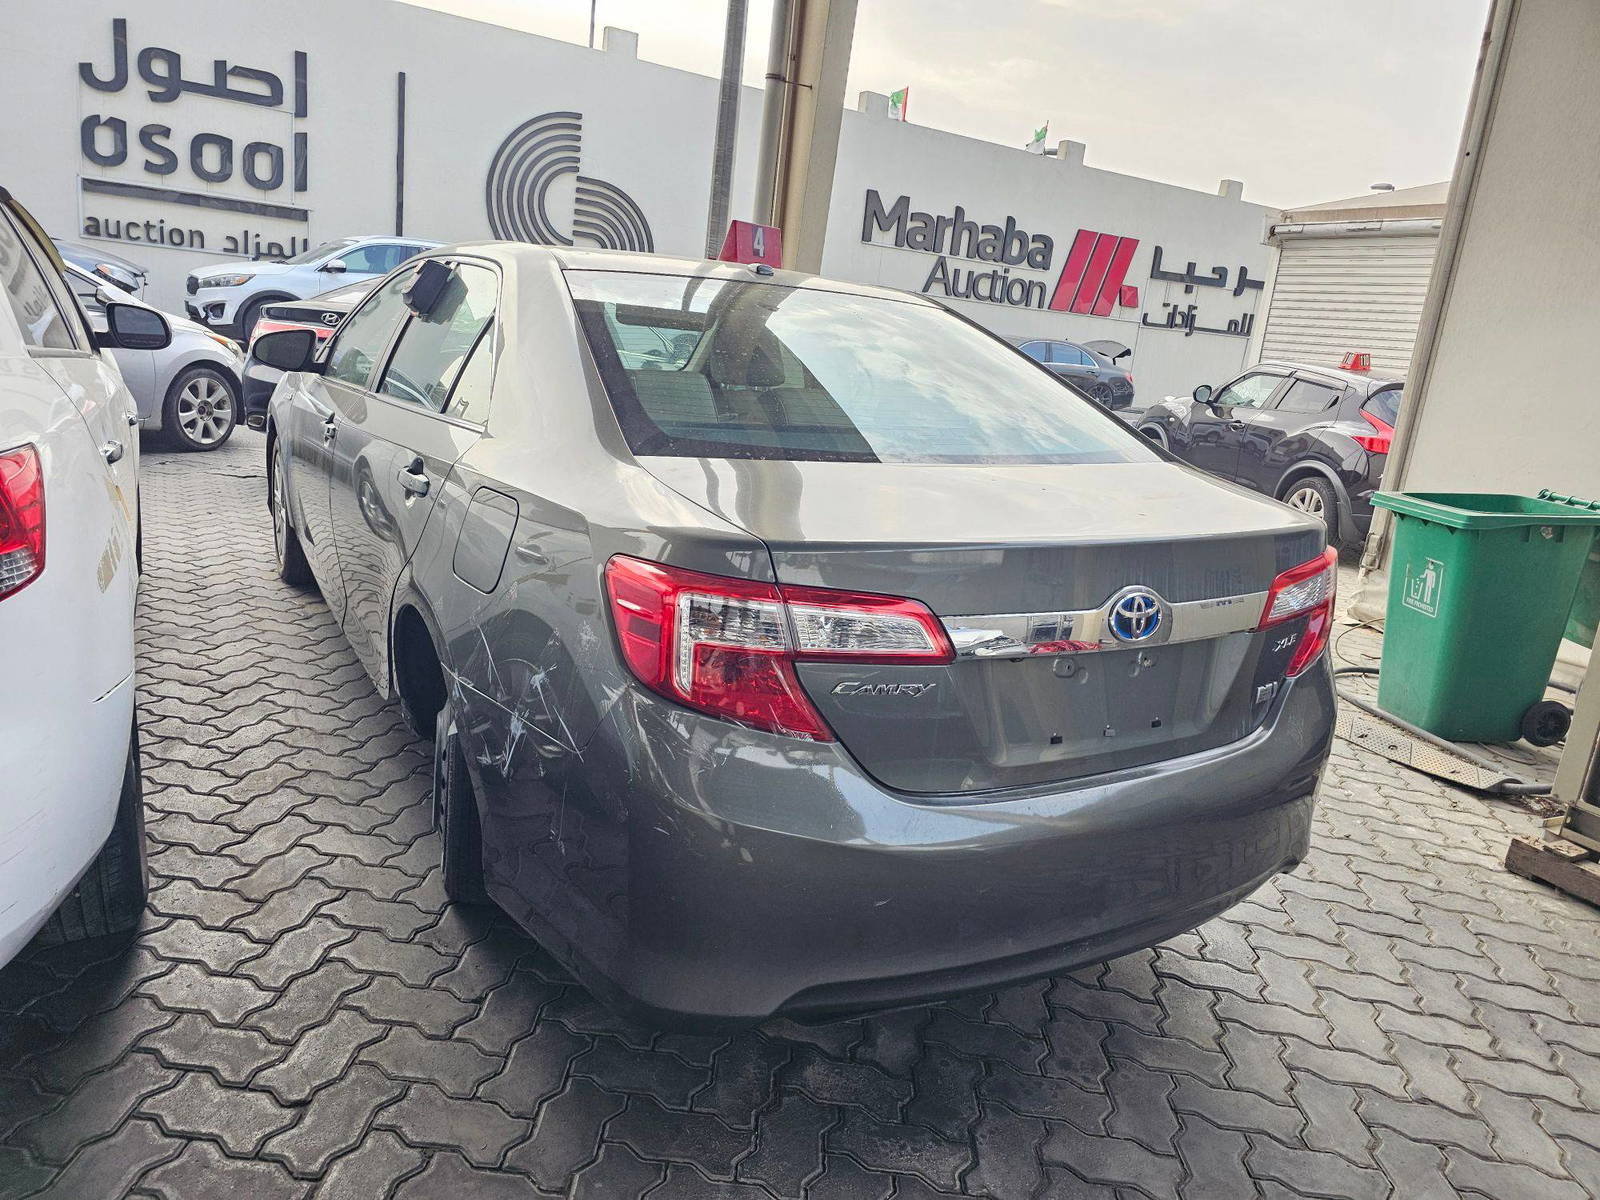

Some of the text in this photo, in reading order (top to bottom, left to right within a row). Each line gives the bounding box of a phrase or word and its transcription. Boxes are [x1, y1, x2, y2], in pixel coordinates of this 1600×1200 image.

[78, 17, 308, 118] اصول
[80, 113, 308, 193] osool
[84, 216, 205, 249] auction
[753, 227, 765, 258] 4
[861, 188, 1054, 271] Marhaba
[922, 256, 1047, 309] Auction
[831, 681, 937, 698] CAMRY
